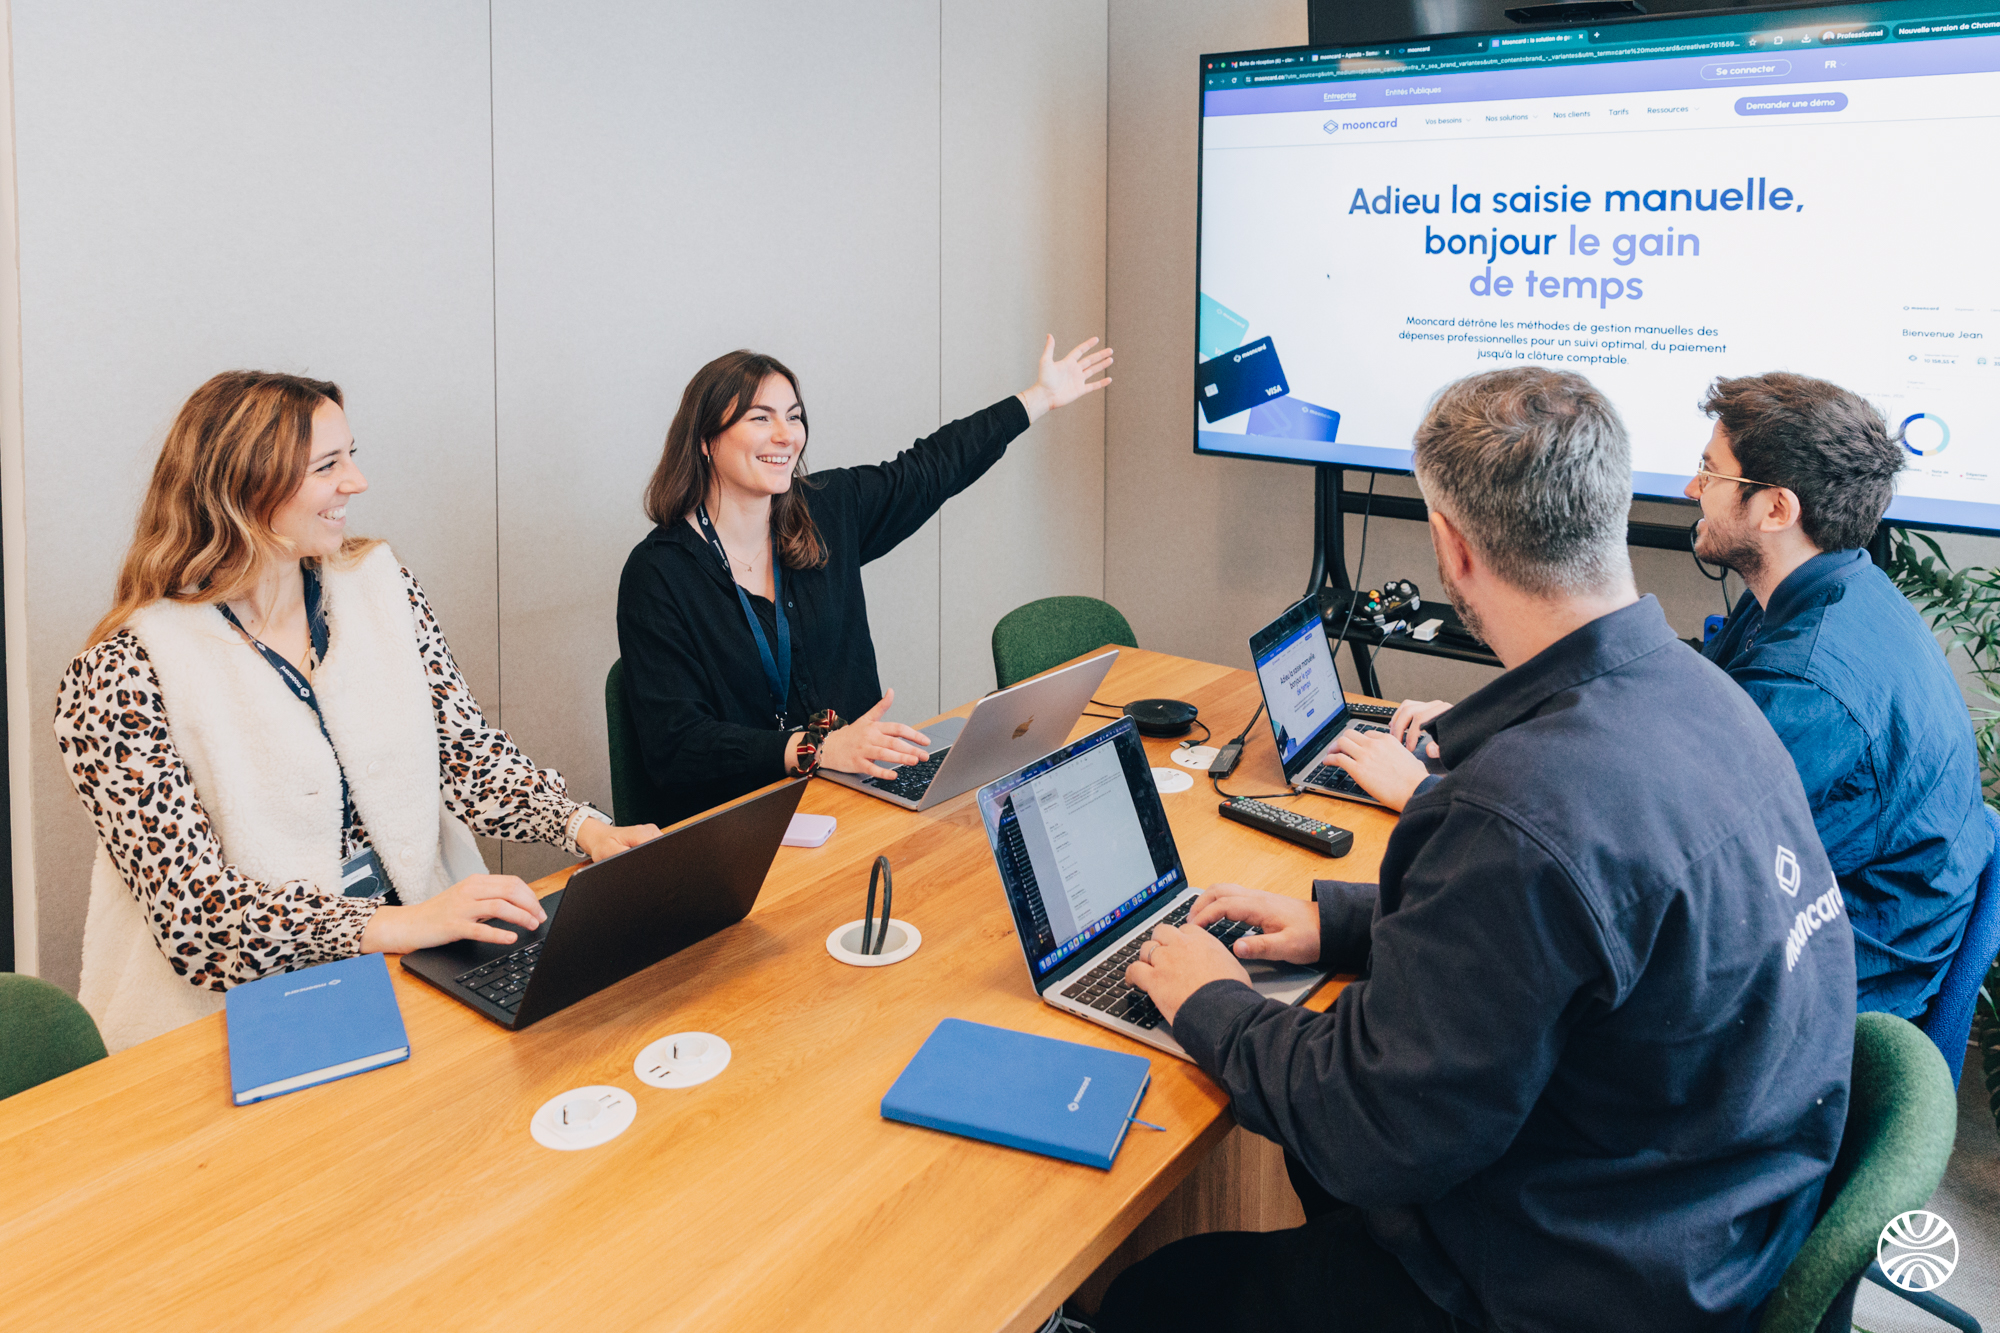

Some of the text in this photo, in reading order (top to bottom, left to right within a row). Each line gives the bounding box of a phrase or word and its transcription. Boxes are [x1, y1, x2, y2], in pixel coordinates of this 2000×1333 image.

[1899, 21, 2000, 35] Nouvelle version de Chrome
[1837, 29, 1883, 40] Professionnel
[1502, 38, 1526, 46] Mooncard
[1716, 64, 1776, 76] Se connecter
[1824, 60, 1837, 69] FR
[1323, 92, 1357, 102] Entreprise
[1385, 86, 1442, 97] Entités Publiques
[1647, 105, 1689, 114] Ressources
[1746, 98, 1836, 110] Demander une démo
[1499, 113, 1529, 121] solutions
[1553, 110, 1591, 119] Nos clients
[1609, 108, 1630, 116] Tarifs
[1342, 117, 1398, 130] mooncard
[1438, 116, 1463, 125] besoins
[1349, 177, 1804, 215] Adieu la saisie manuelle,
[1425, 223, 1701, 266] bonjour le gain
[1469, 266, 1644, 309] de temps
[1406, 316, 1719, 337] Mooncard détrône les méthodes de gestion manuelles des
[1902, 328, 1983, 339] Bienvenue Jean
[1398, 330, 1727, 354] dépenses professionnelles pour un suivi optimal, du paiement
[1241, 343, 1267, 359] mooncard
[1515, 349, 1525, 360] la
[1527, 350, 1564, 362] clôture
[1566, 354, 1630, 366] comptable.
[1265, 384, 1283, 397] VISA
